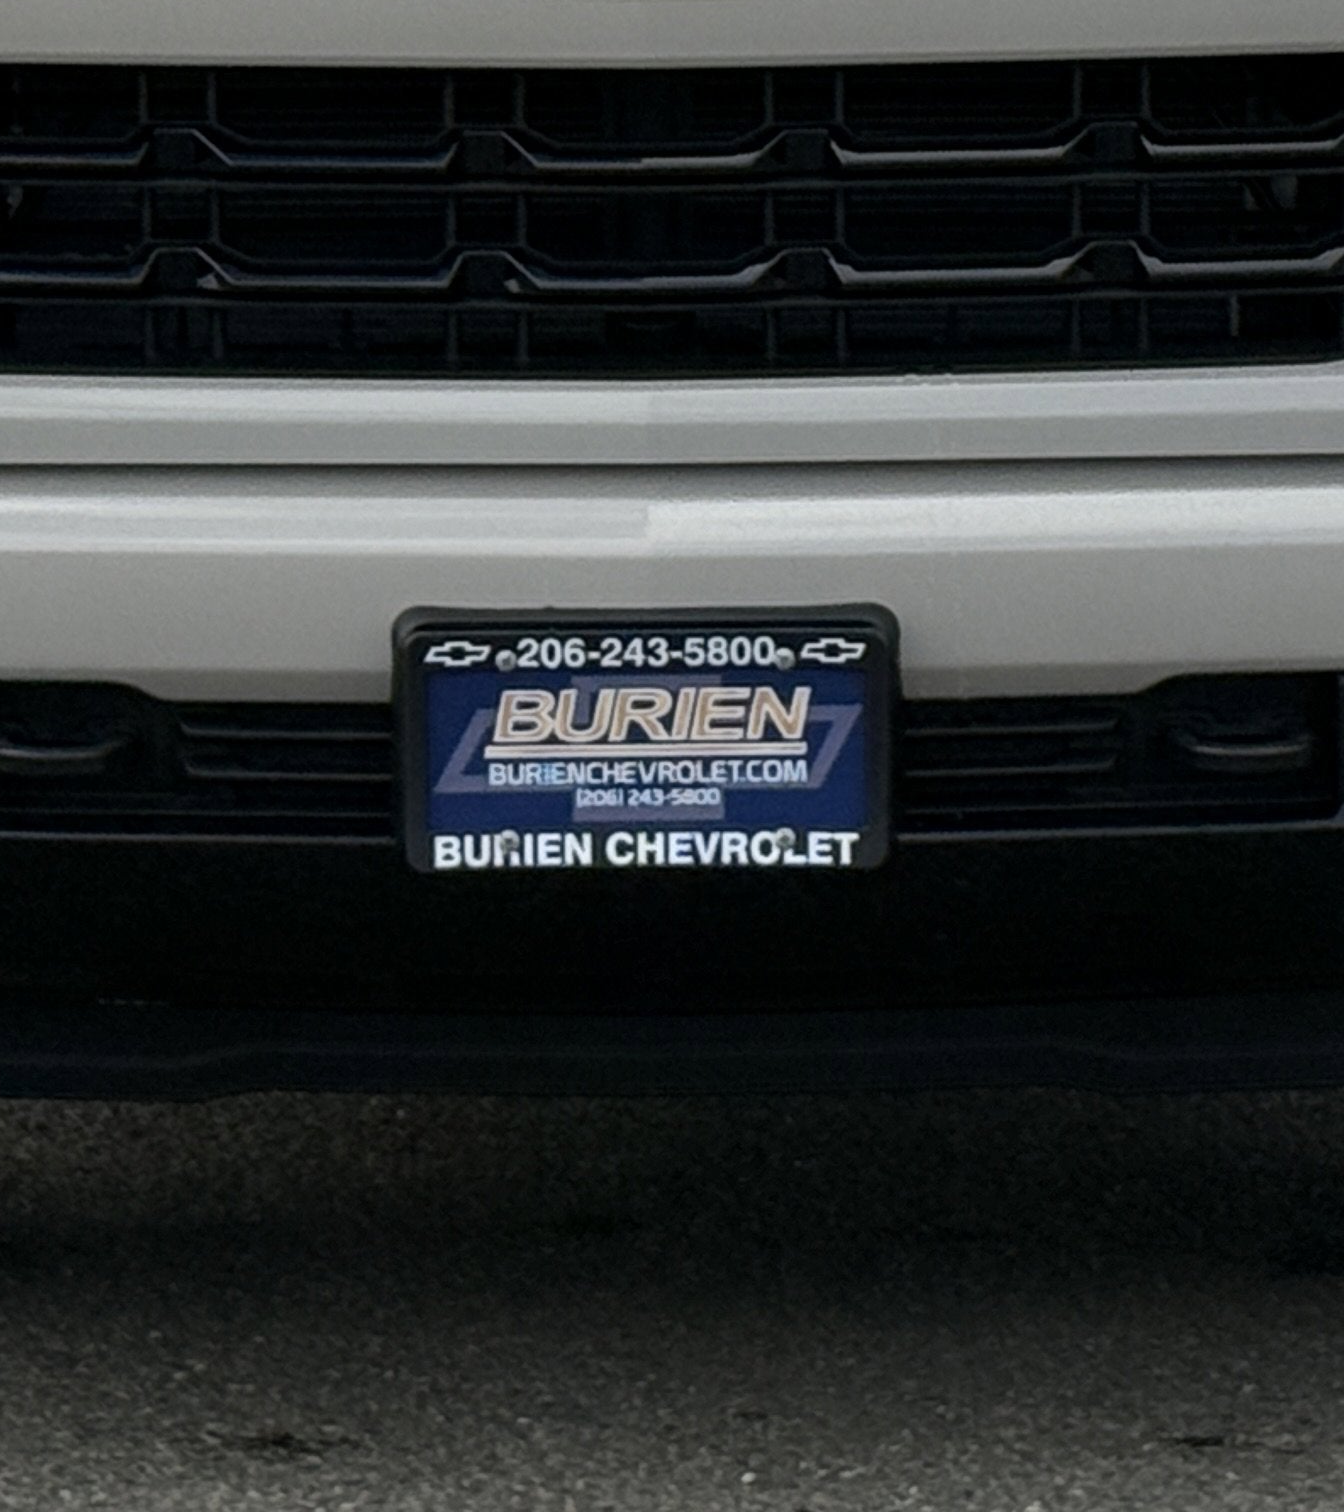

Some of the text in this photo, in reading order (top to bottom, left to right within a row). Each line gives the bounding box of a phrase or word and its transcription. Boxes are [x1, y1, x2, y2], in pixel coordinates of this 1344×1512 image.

[517, 636, 775, 669] 206-243-5800
[494, 686, 812, 742] BURIEN
[489, 759, 807, 786] BURIENCHEVROLET.COM
[627, 787, 721, 806] 243-5800
[433, 831, 860, 868] BURIEN CHEVROLET
